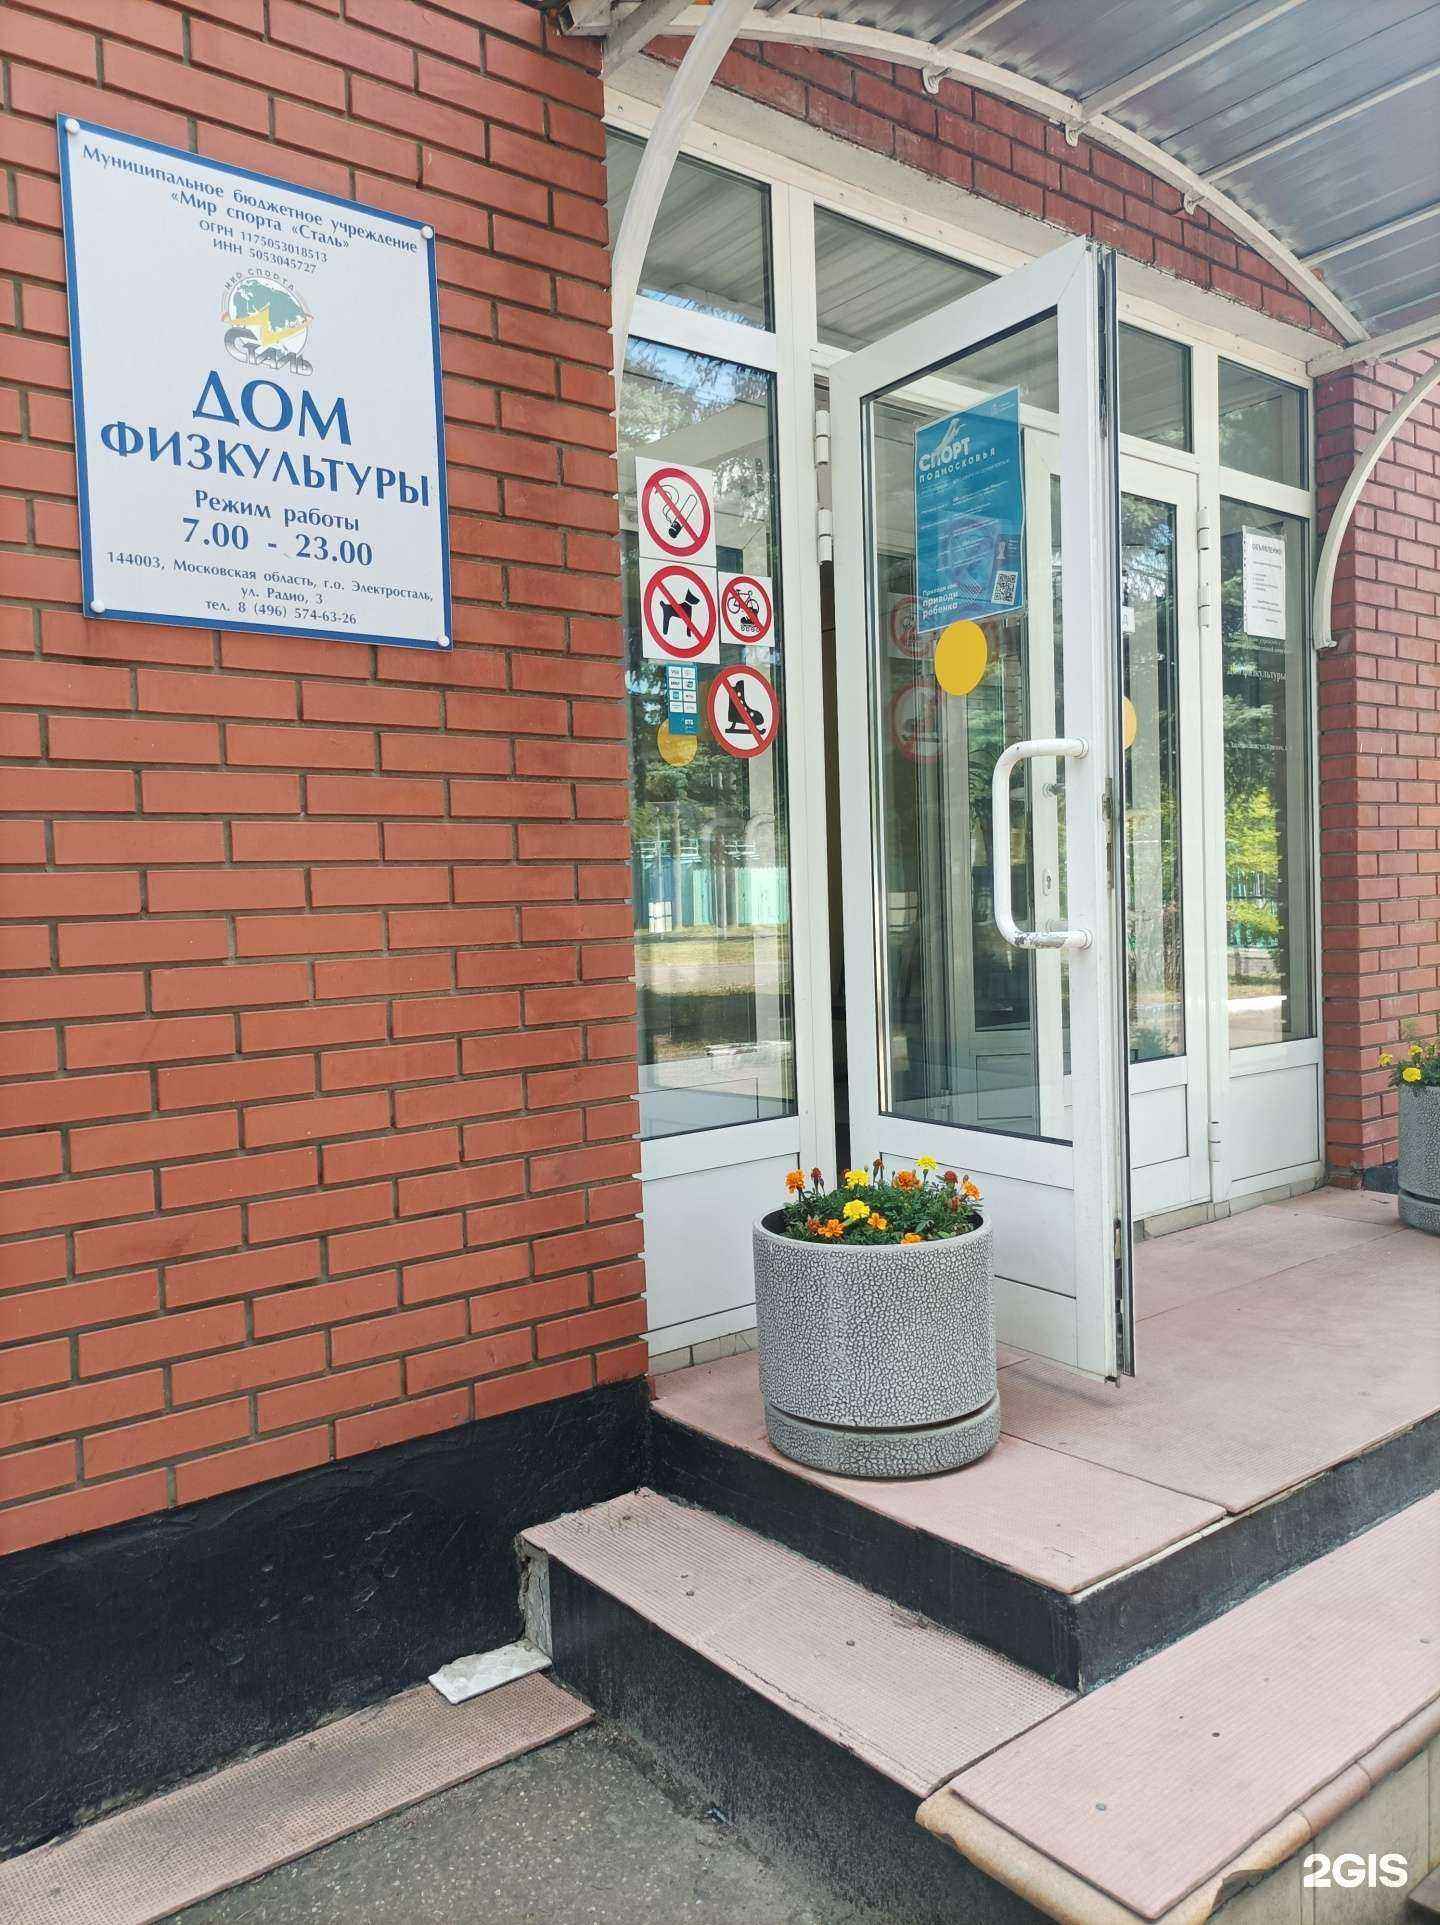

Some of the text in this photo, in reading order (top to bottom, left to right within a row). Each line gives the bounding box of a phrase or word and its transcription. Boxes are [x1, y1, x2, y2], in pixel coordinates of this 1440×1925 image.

[83, 145, 418, 254] Муниципальное бюджетное учреждение
[170, 190, 350, 249] «Мир спорта «Сталь»
[199, 219, 328, 263] ОГРН 1175053018513
[212, 238, 317, 275] ИНН 5053045727
[192, 370, 352, 446] ДОМ
[100, 421, 431, 507] ФИЗКУЛЬТУРЫ
[918, 437, 971, 472] СПОРТ
[919, 447, 996, 483] ПОДМОСКОВЬЯ
[195, 489, 360, 531] Режим работы
[182, 517, 250, 551] 7.00
[294, 533, 373, 567] 23.00
[107, 551, 165, 571] 144003,
[173, 559, 257, 581] Московская
[263, 569, 318, 588] область,
[351, 580, 434, 602] Электросталь,
[241, 587, 324, 605] ул. Радио, 3
[205, 600, 357, 625] тел. 8 (496) 574-63-26
